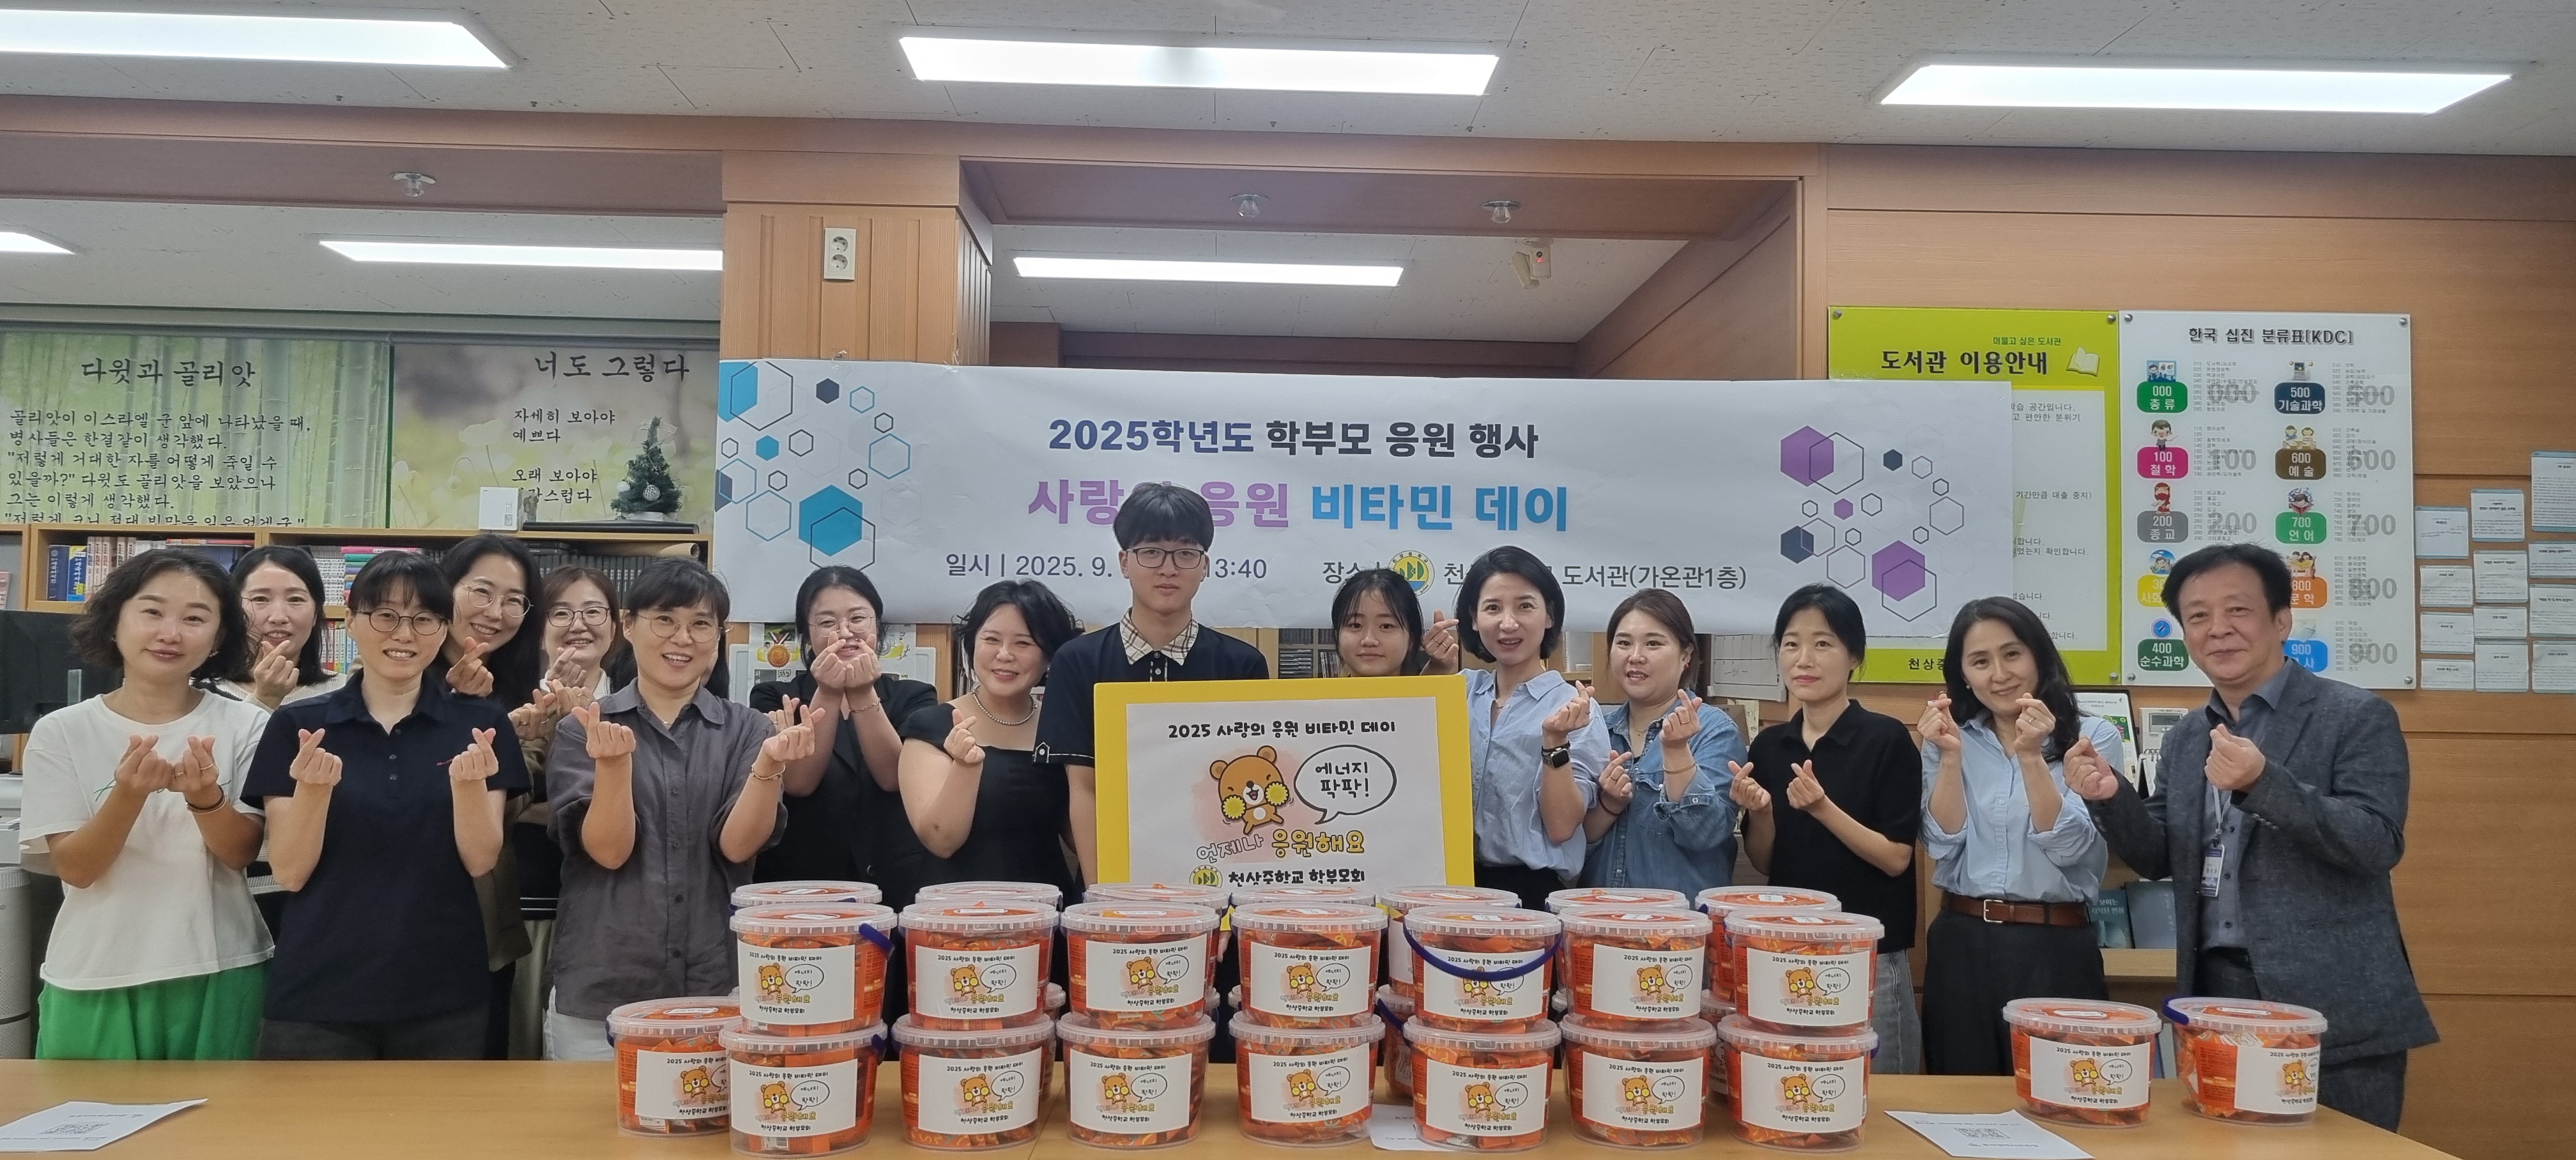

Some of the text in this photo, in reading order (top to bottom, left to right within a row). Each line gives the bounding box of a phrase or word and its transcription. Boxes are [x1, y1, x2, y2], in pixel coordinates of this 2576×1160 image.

[1993, 337, 2061, 346] 머물고 싶은 도서관
[2188, 327, 2218, 342] 한국
[2225, 328, 2253, 343] 십진
[534, 351, 690, 383] 너도 그렇다
[1881, 351, 2047, 375] 도서관 이용안내
[80, 357, 256, 388] 다윗과 골리앗
[2152, 385, 2172, 397] 000
[2290, 387, 2310, 398] 500
[2029, 403, 2075, 411] 공간입니다.
[2278, 399, 2324, 412] 기술과학
[10, 409, 310, 432] 골리앗이 이스라엘 군 앞에 나타났을 때,
[514, 408, 615, 425] 자세히 보아야
[2025, 413, 2050, 422] 편안한
[10, 429, 227, 450] 병사들은 한결같이 생각했다.
[512, 427, 561, 443] 예쁘다
[1049, 419, 1539, 459] 2025학년도 학부모 응원 행사
[73, 451, 121, 468] 거대한
[128, 452, 160, 469] 자를
[167, 453, 214, 471] 어떻게
[222, 455, 252, 471] 죽일
[261, 455, 277, 471] 수
[2154, 451, 2172, 462] 100
[2291, 452, 2311, 464] 600
[81, 471, 130, 488] 다윗도
[136, 473, 204, 491] 골리앗을
[209, 475, 276, 491] 보았으나
[512, 468, 597, 484] 오래 보아야
[6, 492, 174, 509] 그는 이렇게 생각했다.
[1200, 481, 1289, 528] 응원
[1312, 484, 1452, 530] 비타민
[1475, 485, 1567, 532] 데이
[2152, 515, 2172, 527] 200
[2291, 517, 2311, 528] 700
[946, 553, 990, 577] 일시
[1561, 565, 1747, 590] 도서관(가온관1층)
[2292, 581, 2311, 591] 800
[2152, 643, 2172, 653] 400
[2292, 644, 2311, 654] 900
[2140, 655, 2184, 668] 순수과학
[1168, 720, 1395, 738] 2025 사랑의 응원 비타민 데이
[1315, 761, 1368, 775] 에너지
[1320, 777, 1369, 799] 팍팍!
[1196, 829, 1365, 863] 언제나 응원해요
[1228, 868, 1365, 886] 천상중학교 학부모회
